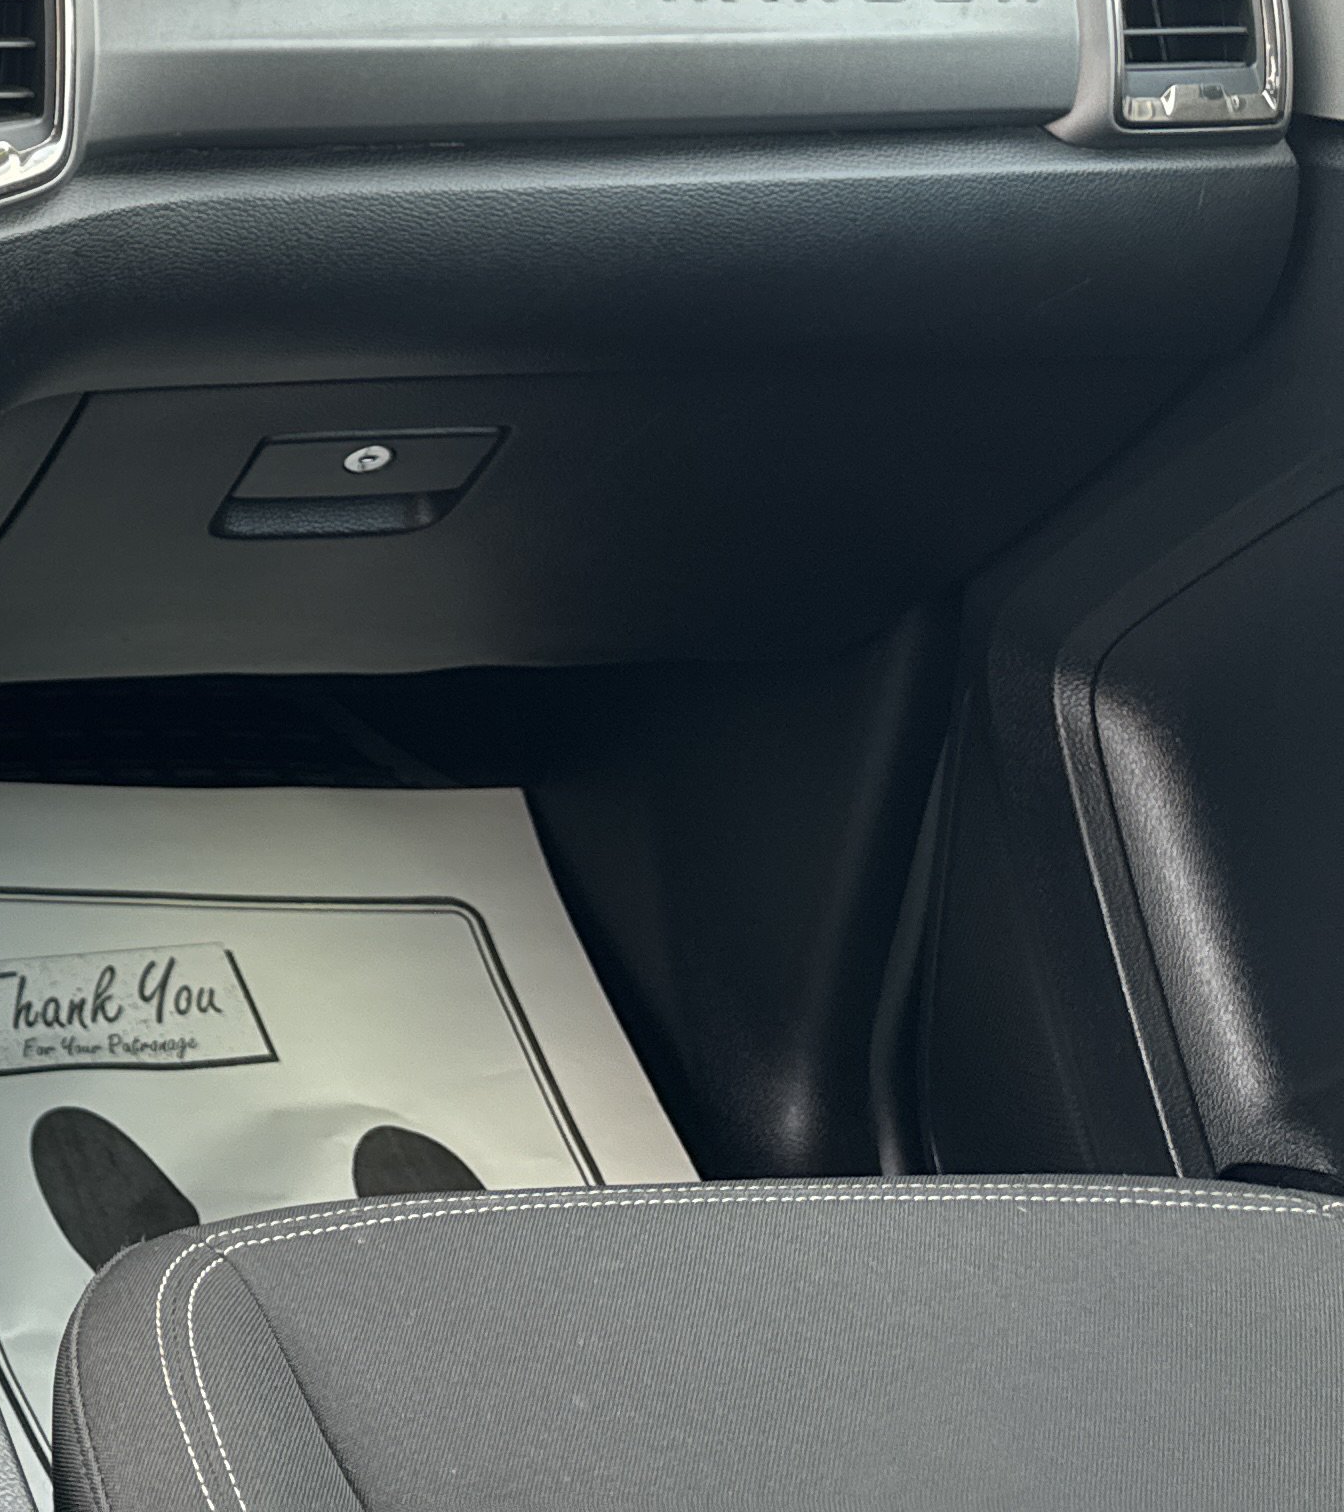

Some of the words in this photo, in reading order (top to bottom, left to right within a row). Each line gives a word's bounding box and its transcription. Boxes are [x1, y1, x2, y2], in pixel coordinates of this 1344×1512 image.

[139, 956, 224, 1024] You
[23, 1038, 56, 1058] For
[62, 1036, 102, 1056] Your
[108, 1033, 198, 1059] Patronage
